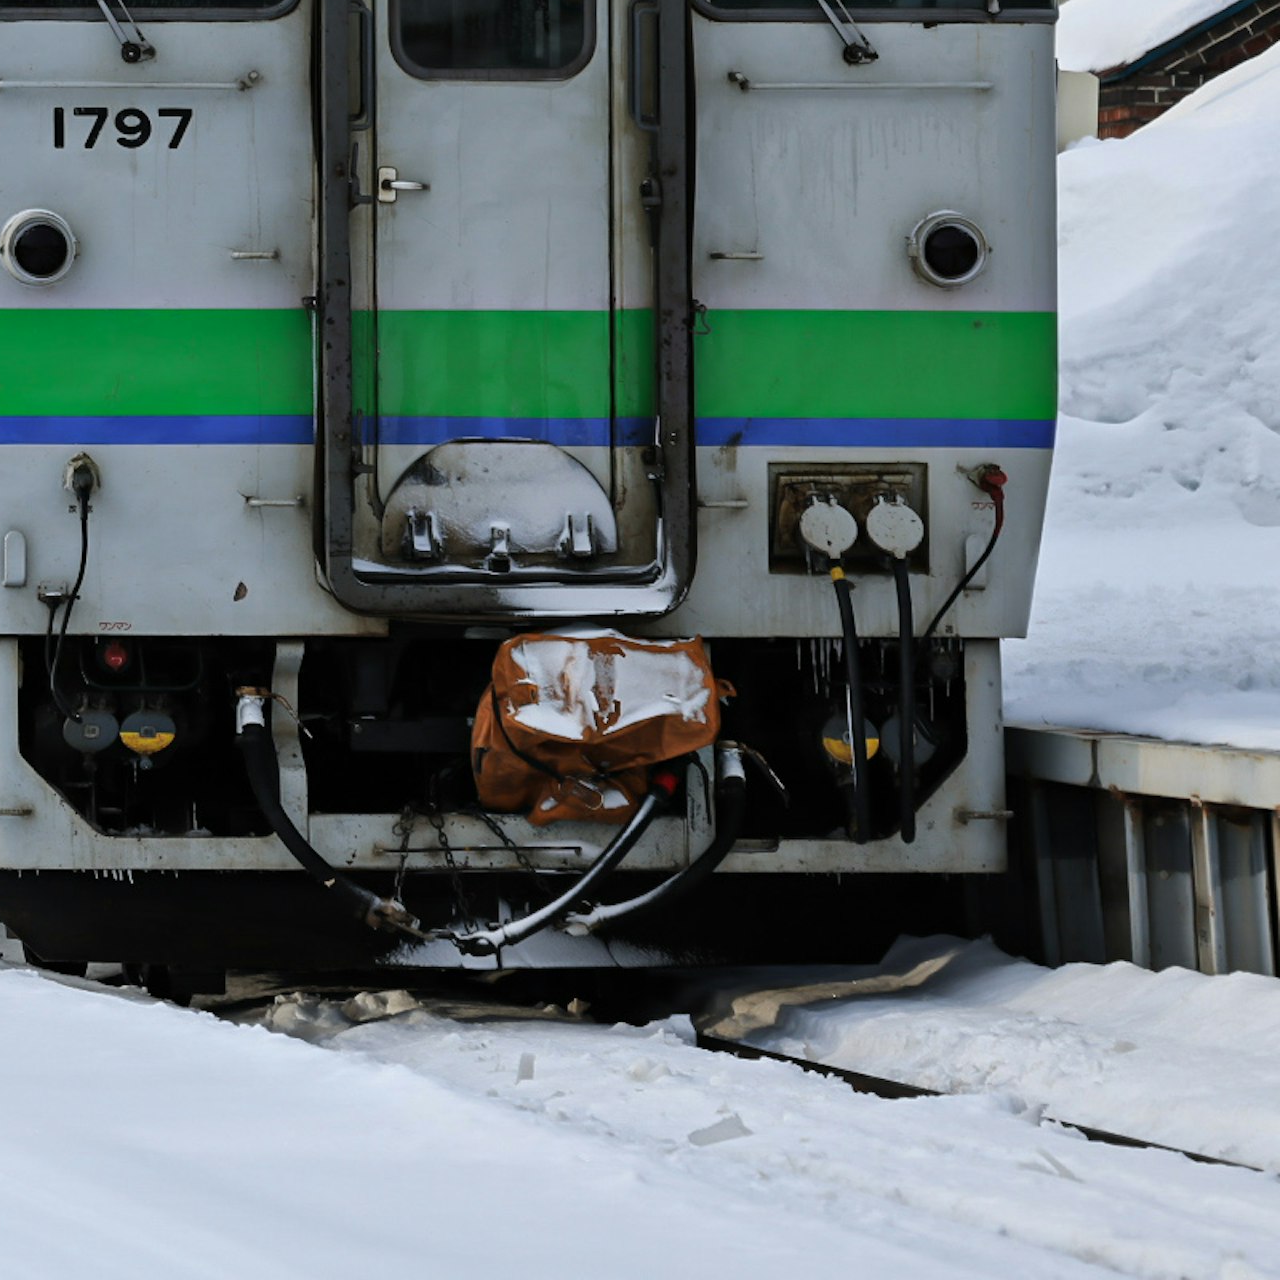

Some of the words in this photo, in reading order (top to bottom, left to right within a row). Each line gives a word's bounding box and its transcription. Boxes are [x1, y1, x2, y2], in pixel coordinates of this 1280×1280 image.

[54, 107, 192, 149] 1797
[99, 621, 132, 631] ワンマン
